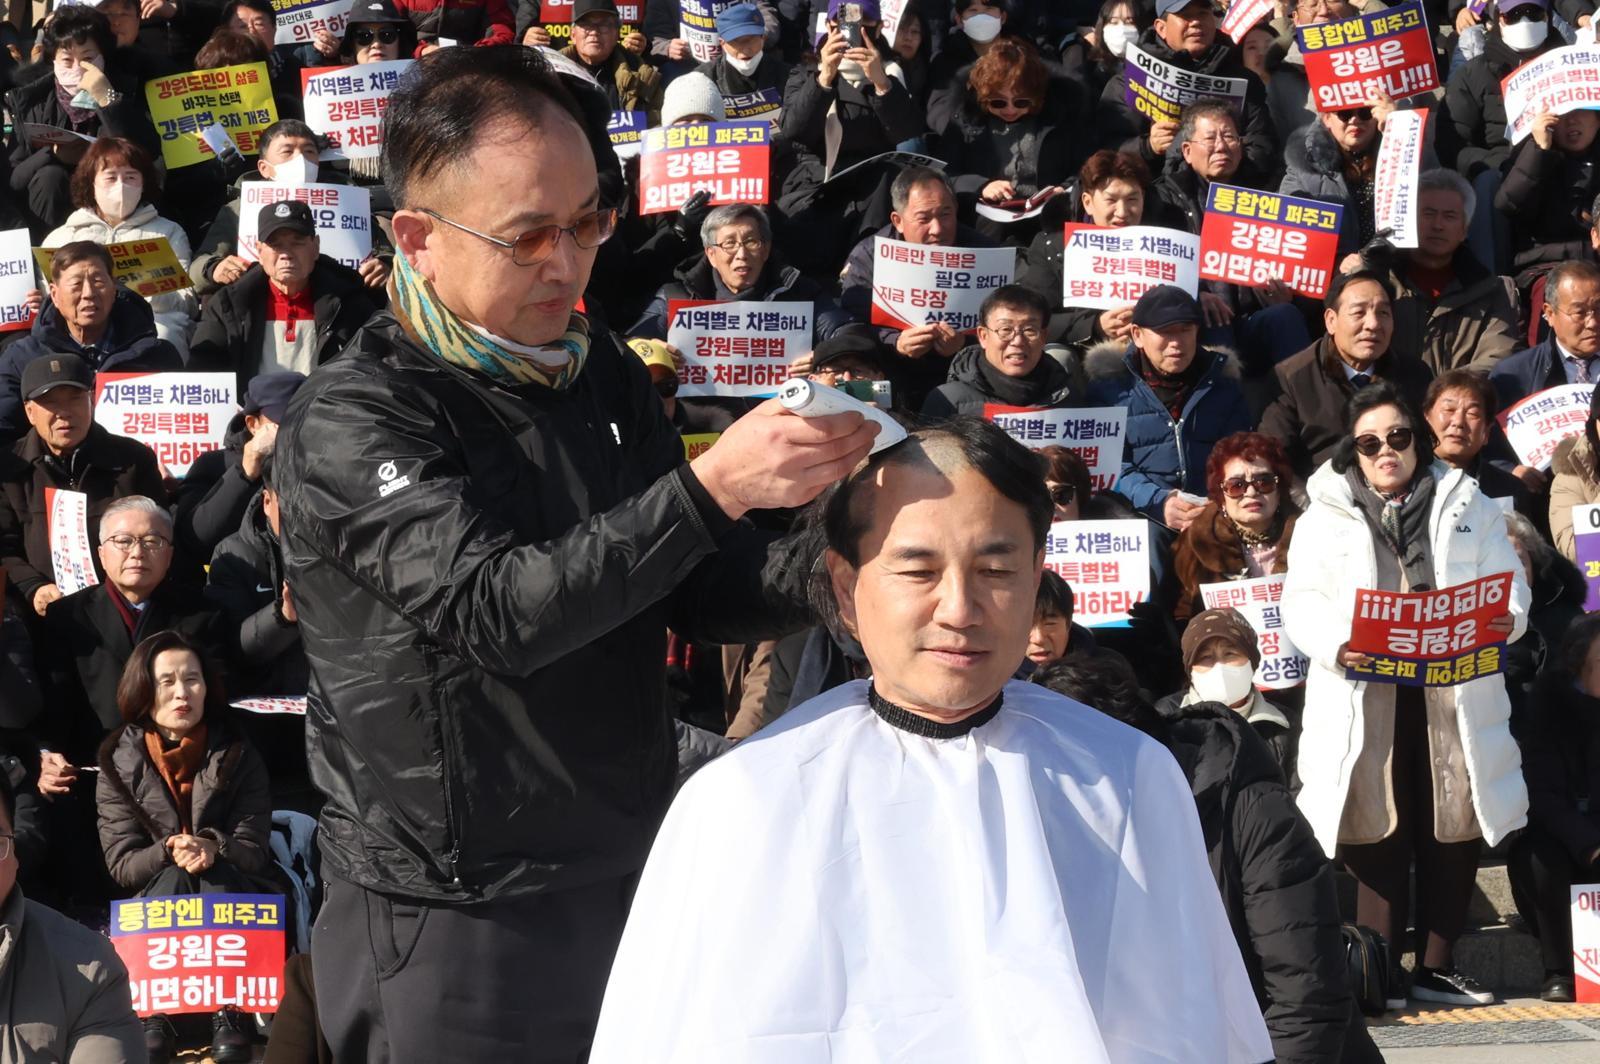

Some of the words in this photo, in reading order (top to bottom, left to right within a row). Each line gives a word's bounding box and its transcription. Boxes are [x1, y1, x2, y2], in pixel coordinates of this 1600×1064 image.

[544, 24, 573, 37] 300
[1302, 19, 1367, 50] 통합엔
[1371, 9, 1420, 36] 퍼주고
[1329, 40, 1405, 77] 강원은
[156, 71, 232, 99] 강원도민의
[235, 69, 259, 86] 삶을
[308, 75, 364, 97] 지역별로
[369, 70, 401, 91] 차별
[1137, 53, 1169, 80] 여야
[1176, 71, 1232, 94] 공동의
[1318, 63, 1433, 108] 외면하나!!!
[1524, 68, 1599, 102] 강원특별법
[182, 94, 218, 111] 바꾸는
[219, 91, 242, 106] 선택
[219, 112, 242, 128] 3차
[243, 108, 271, 124] 개정
[348, 125, 385, 148] 처리
[715, 127, 765, 144] 퍼주고
[667, 150, 741, 178] 강원은
[247, 187, 290, 204] 이름만
[295, 187, 339, 206] 특별은
[1214, 187, 1280, 221] 통합엔
[1285, 204, 1336, 229] 퍼주고
[341, 214, 368, 231] 없다!
[1072, 232, 1133, 252] 지역별로
[1140, 235, 1195, 261] 차별하나
[1231, 221, 1308, 259] 강원은
[116, 258, 142, 270] 선택
[881, 243, 925, 265] 이름만
[930, 251, 976, 269] 특별은
[936, 271, 971, 289] 필요
[976, 274, 1007, 289] 없다!
[1092, 256, 1176, 282] 강원특별법
[879, 285, 905, 303] 지금
[911, 288, 947, 309] 당장
[1070, 280, 1104, 298] 당장
[1110, 281, 1153, 300] 처리
[675, 310, 741, 330] 지역별로
[746, 311, 807, 332] 차별하나
[695, 336, 785, 358] 강원특별법
[103, 384, 164, 405] 지역별로
[170, 384, 230, 405] 차별하나
[1507, 397, 1569, 429] 지역별로
[1571, 391, 1593, 405] 차
[1535, 409, 1592, 435] 강원특
[122, 412, 210, 434] 강원특별법
[1062, 418, 1120, 440] 차별하나
[1075, 533, 1142, 554] 차별하나
[1073, 591, 1143, 615] 리하라!
[1251, 581, 1283, 602] 특별
[1360, 578, 1505, 622] 외면하나!!!
[1261, 606, 1282, 629] 필
[1259, 632, 1280, 655] 장
[1387, 618, 1477, 655] 강원은
[1425, 647, 1500, 684] 통합엔
[118, 898, 204, 932] 통합엔
[213, 903, 279, 925] 퍼주고
[147, 934, 248, 970] 강원은
